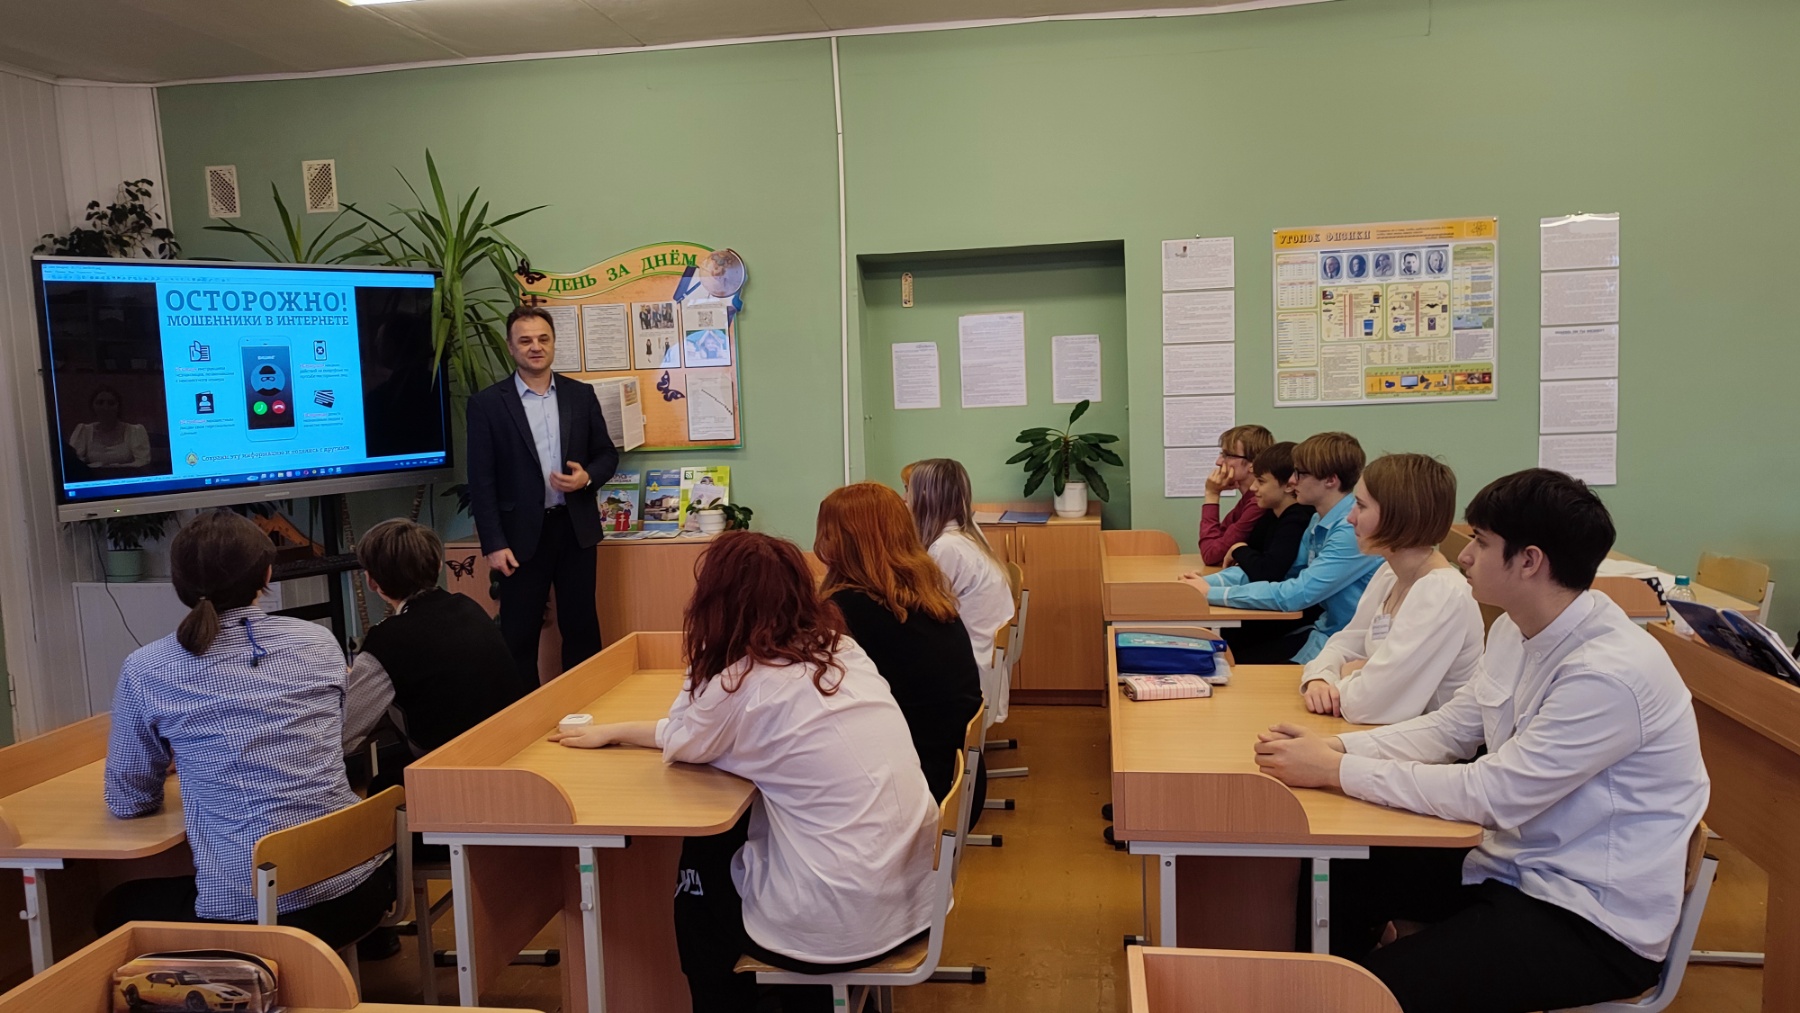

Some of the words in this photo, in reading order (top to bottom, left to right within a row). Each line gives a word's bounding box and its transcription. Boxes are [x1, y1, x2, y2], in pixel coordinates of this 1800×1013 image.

[1280, 233, 1320, 245] УГОЛОК
[1326, 230, 1371, 242] ФИЗИКИ
[547, 273, 597, 294] ДЕНЬ
[606, 263, 631, 282] ЗА
[640, 249, 698, 274] ДНЁМ
[165, 289, 348, 312] ОСТОРОЖНО!
[167, 315, 262, 327] МОШЕННИКИ
[265, 315, 274, 326] В
[276, 315, 349, 326] ИНТЕРНЕТЕ
